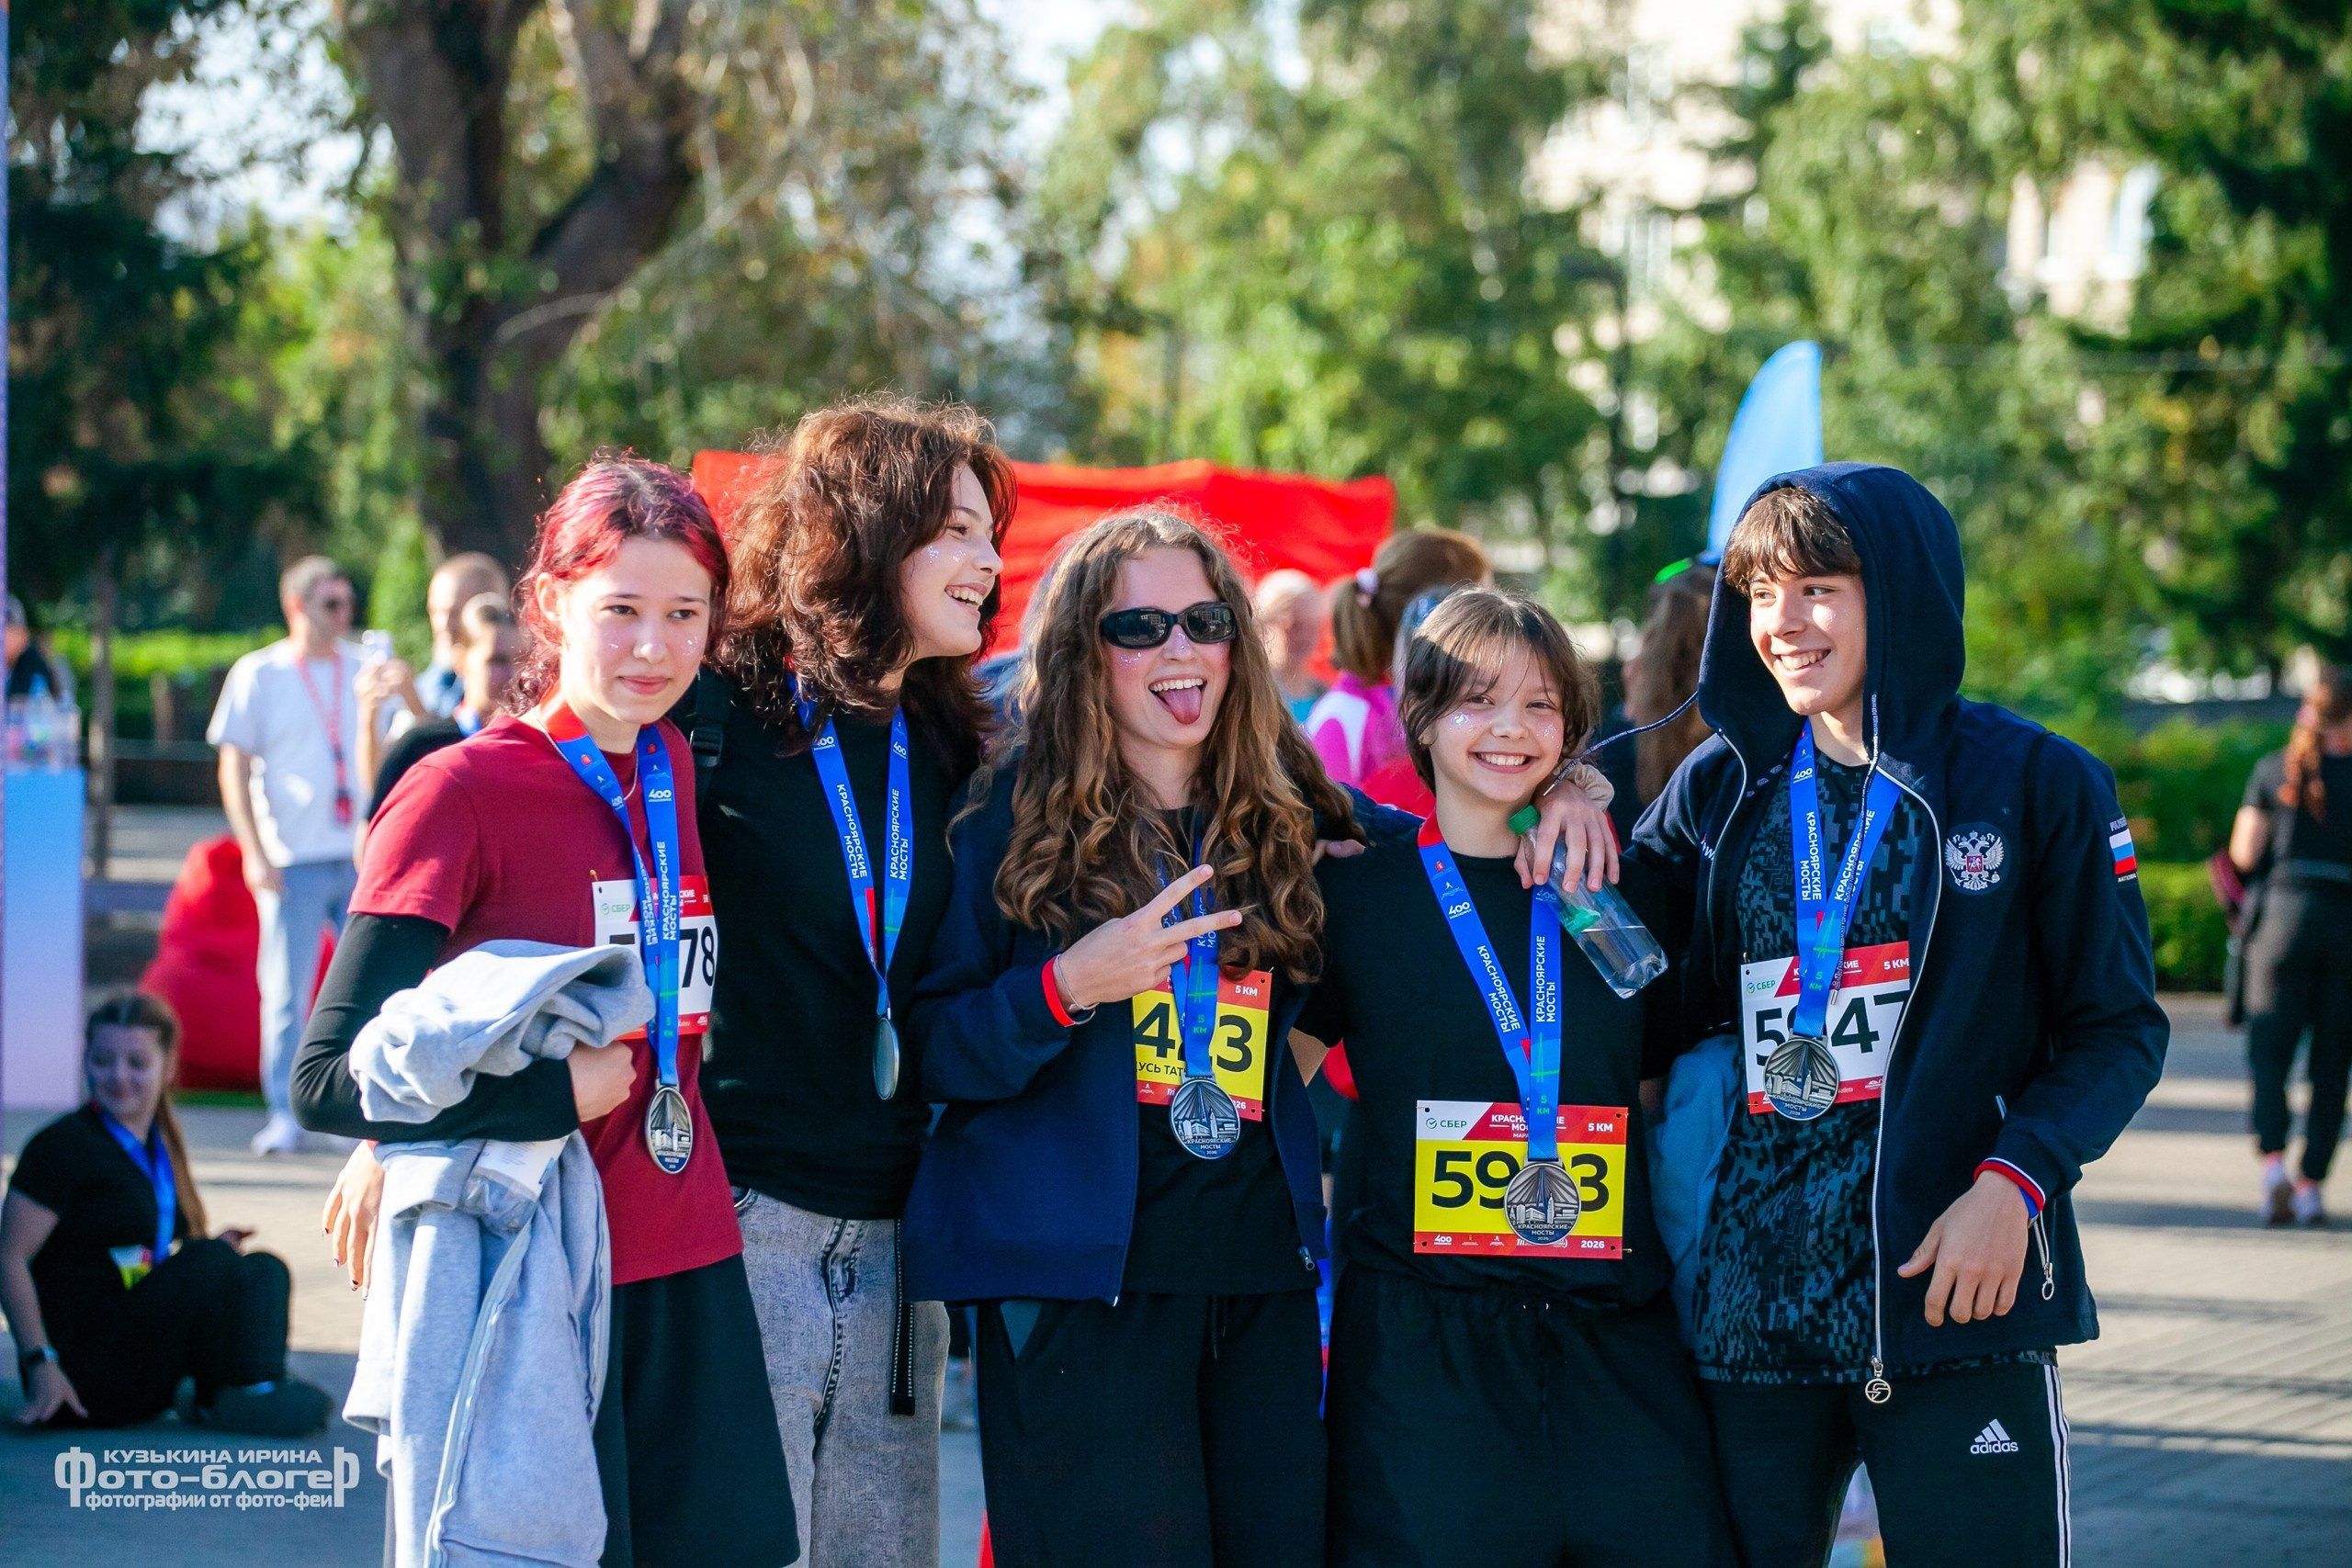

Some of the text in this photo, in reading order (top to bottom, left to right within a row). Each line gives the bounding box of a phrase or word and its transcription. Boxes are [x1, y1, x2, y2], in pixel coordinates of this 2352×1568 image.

[893, 741, 907, 756] 400
[1792, 768, 1813, 780] 400
[649, 788, 672, 799] 400
[837, 784, 868, 877] КРАСНОЯРСКИЕ
[889, 789, 899, 878] КРАСНОЯРСКИЕ
[844, 835, 859, 879] МОСТЫ
[899, 838, 909, 881] МОСТЫ
[1806, 811, 1822, 900] КРАСНОЯРСКИЕ
[1800, 860, 1811, 901] МОСТЫ
[657, 841, 670, 941] КРАСНОЯРСКИЕ
[611, 904, 631, 913] СБЕР
[1448, 902, 1471, 916] 400
[669, 896, 677, 941] МОСТЫ
[1884, 962, 1891, 970] 5
[1536, 935, 1545, 1022] КРАСНОЯРСКИЕ
[1815, 971, 1822, 980] 5
[1235, 985, 1258, 996] 5 КМ
[1476, 945, 1521, 1031] КРАСНОЯРСКИЕ
[1757, 980, 1776, 990] СБЕР
[1546, 982, 1555, 1022] МОСТЫ
[1197, 1014, 1204, 1023] 5
[1488, 992, 1511, 1033] МОСТЫ
[1756, 989, 1910, 1066] 547
[1540, 1095, 1547, 1104] 5
[1440, 1120, 1467, 1129] СБЕР
[1588, 1122, 1613, 1133] 5 КМ
[1431, 1150, 1610, 1212] 593
[1434, 1235, 1452, 1243] 400
[1580, 1239, 1605, 1248] 2026
[1970, 1440, 2018, 1454] adidas
